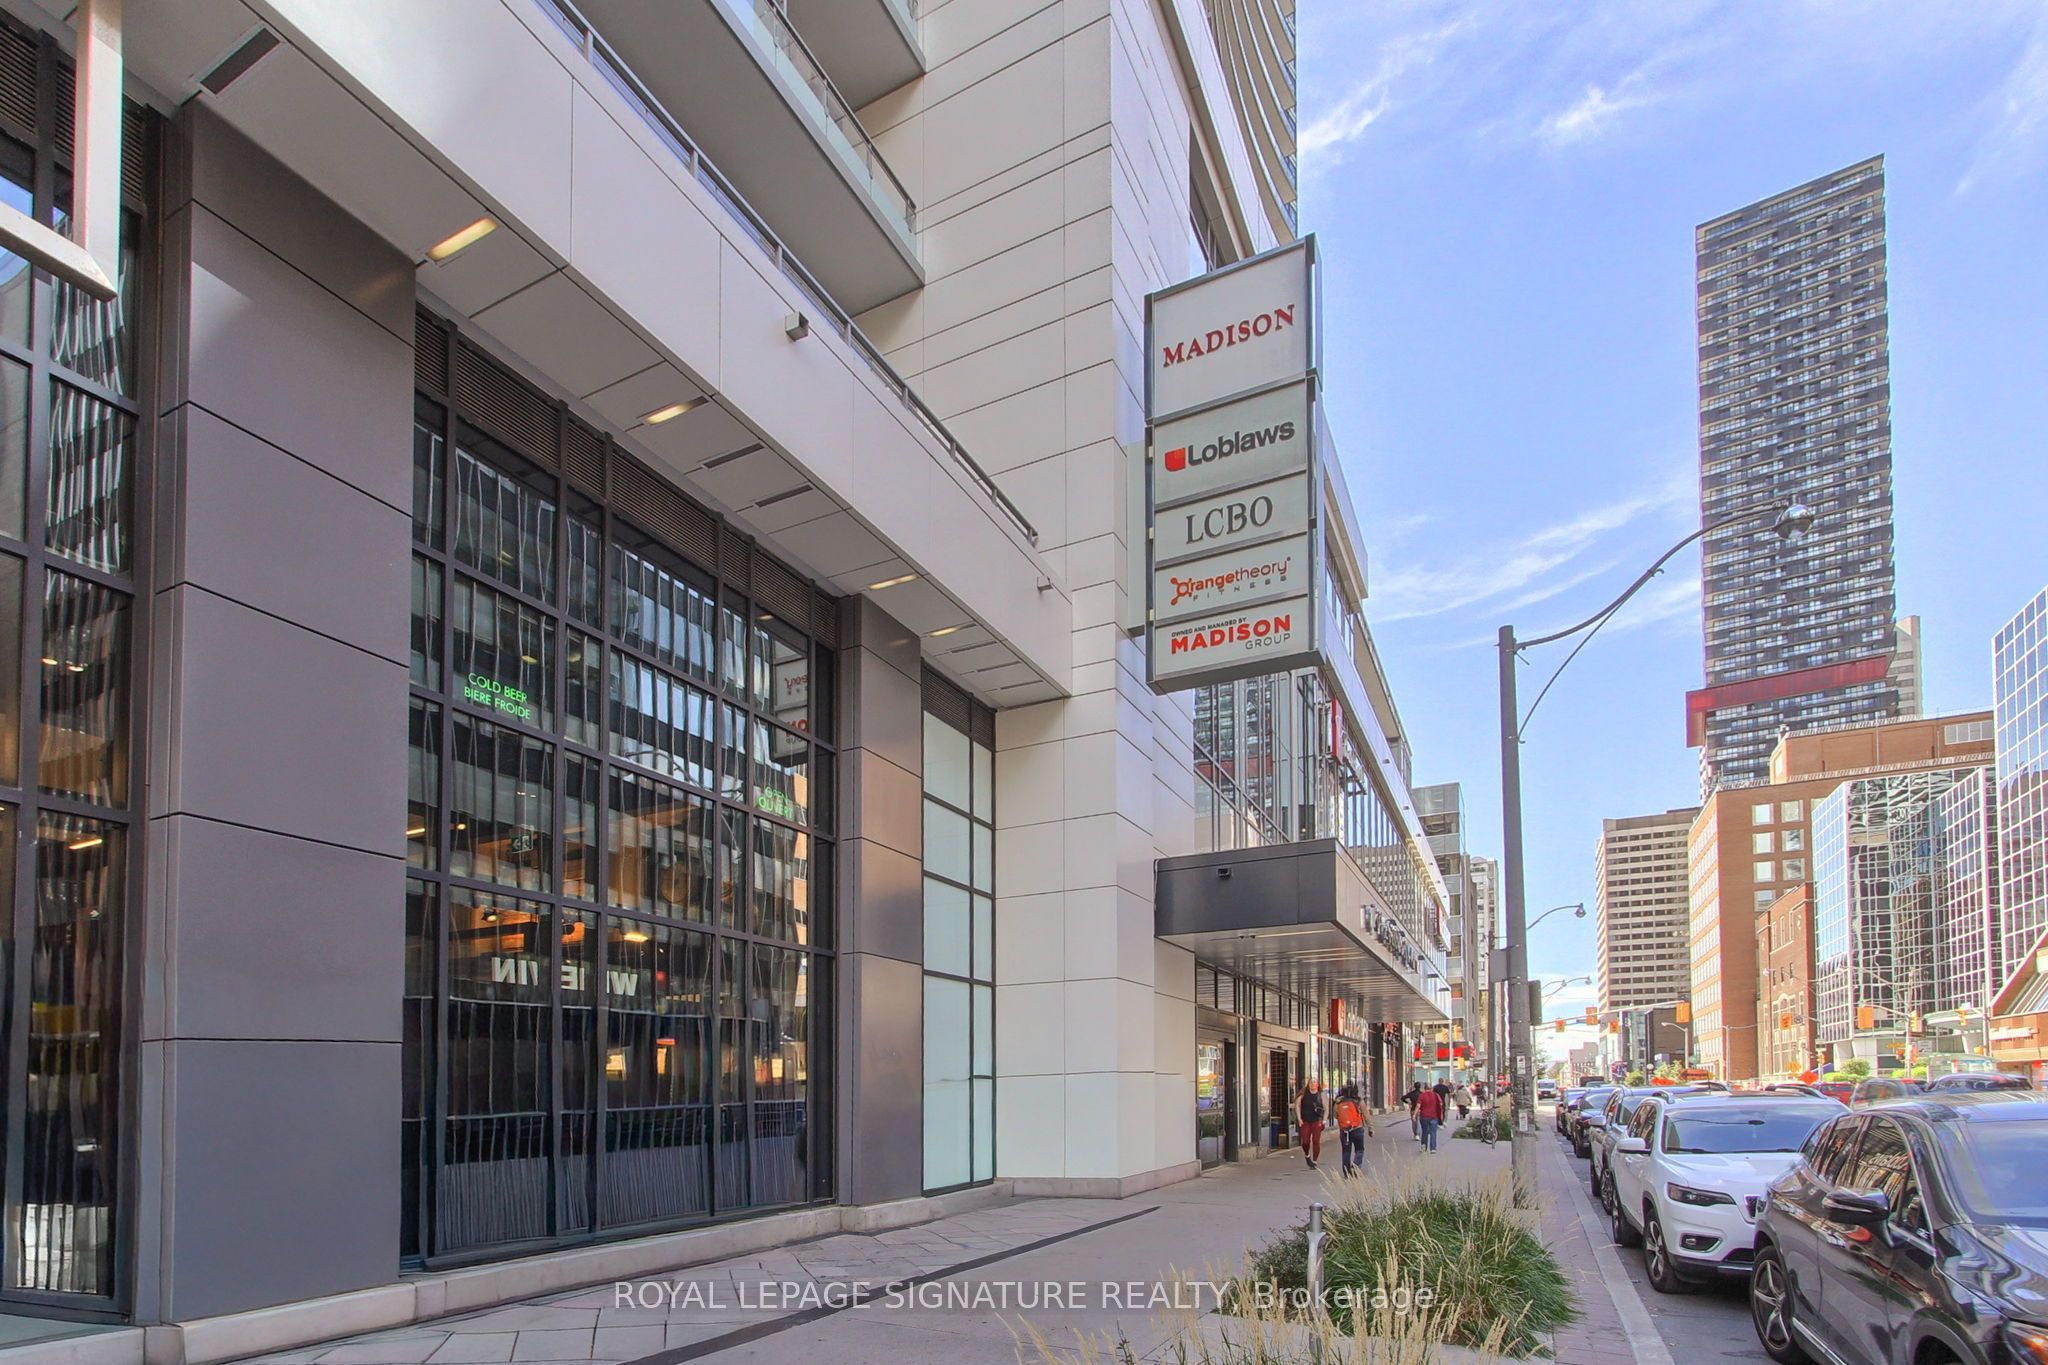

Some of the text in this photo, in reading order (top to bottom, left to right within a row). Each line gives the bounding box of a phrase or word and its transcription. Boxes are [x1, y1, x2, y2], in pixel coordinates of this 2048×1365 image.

[1163, 304, 1295, 368] MADISON
[1188, 421, 1295, 466] Loblaws
[1186, 495, 1273, 544] LCBO
[1170, 614, 1291, 655] MADISON
[1171, 628, 1193, 637] OWNED
[1207, 618, 1237, 630] MANAGED
[1245, 633, 1291, 650] GROUP
[468, 672, 527, 704] COLD BEER
[494, 697, 531, 720] FROIDE
[758, 796, 794, 820] OUVERT
